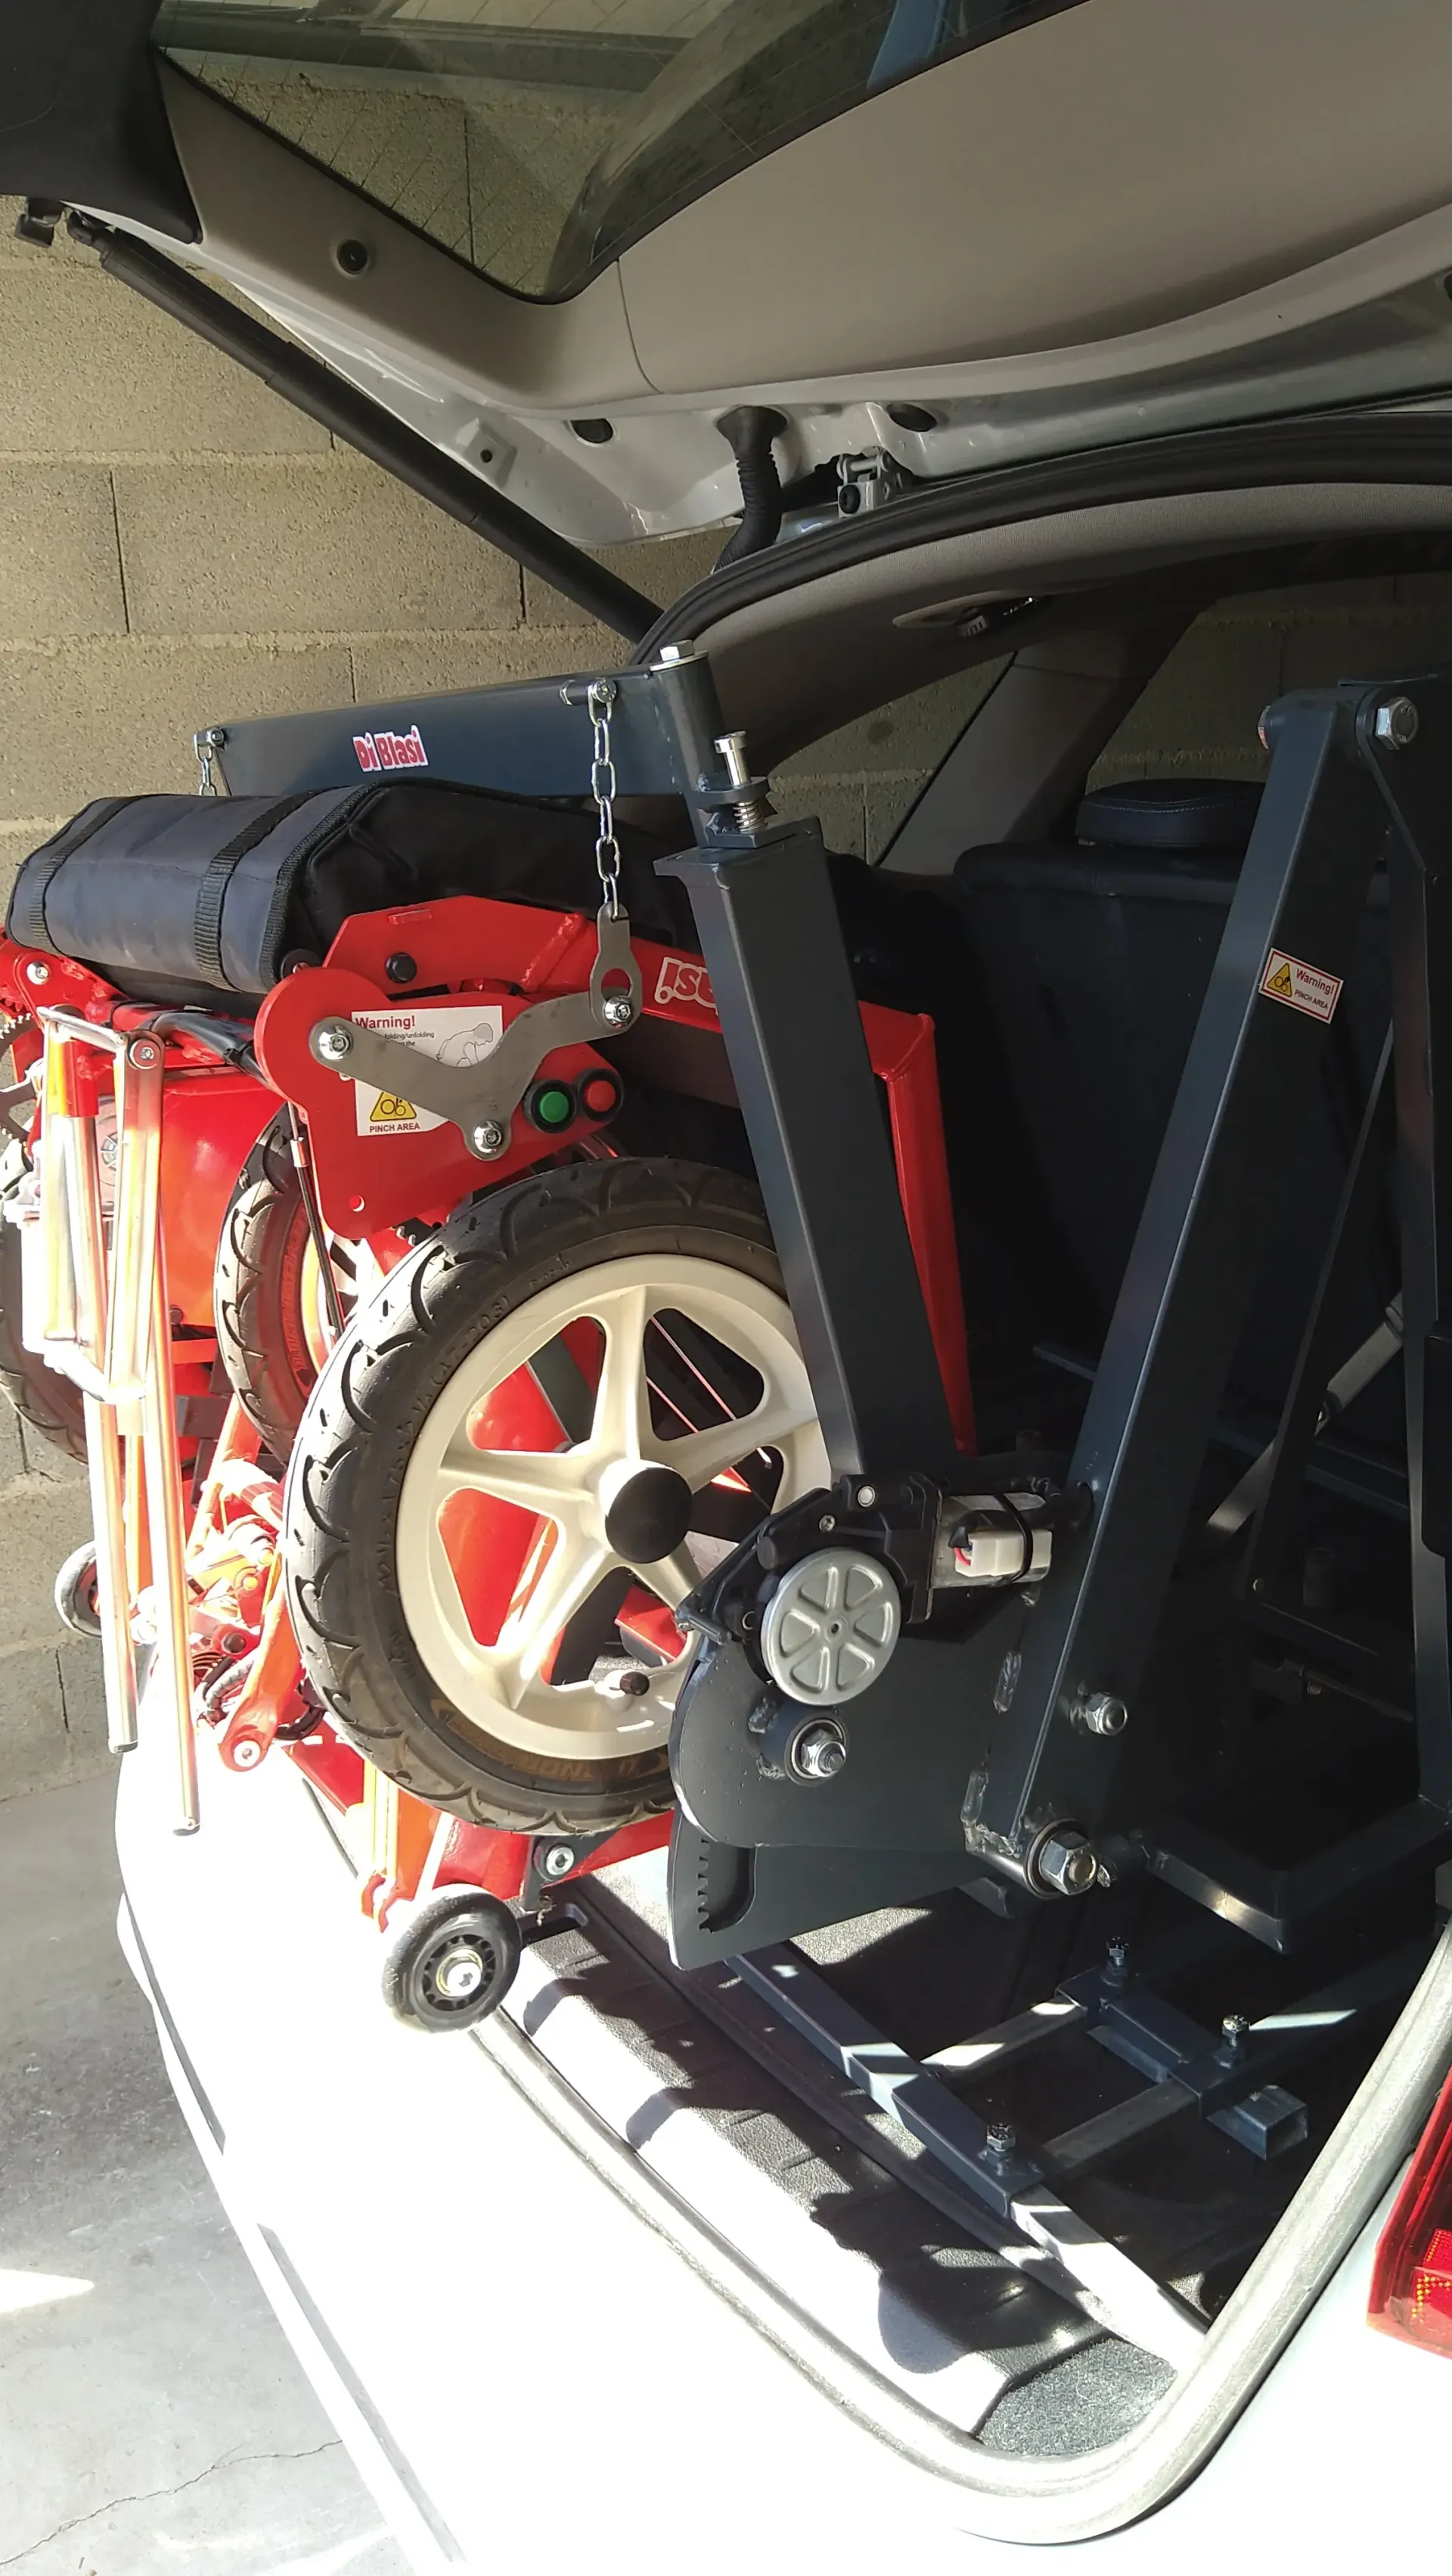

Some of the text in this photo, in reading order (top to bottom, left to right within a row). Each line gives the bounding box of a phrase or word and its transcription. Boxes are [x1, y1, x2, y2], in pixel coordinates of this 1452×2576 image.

[353, 725, 428, 771] Di Blasi
[1295, 968, 1335, 995] Warning!
[1295, 989, 1329, 1010] PINCH AREA
[355, 1015, 415, 1030] Warning!
[369, 1123, 420, 1133] PINCH AREA
